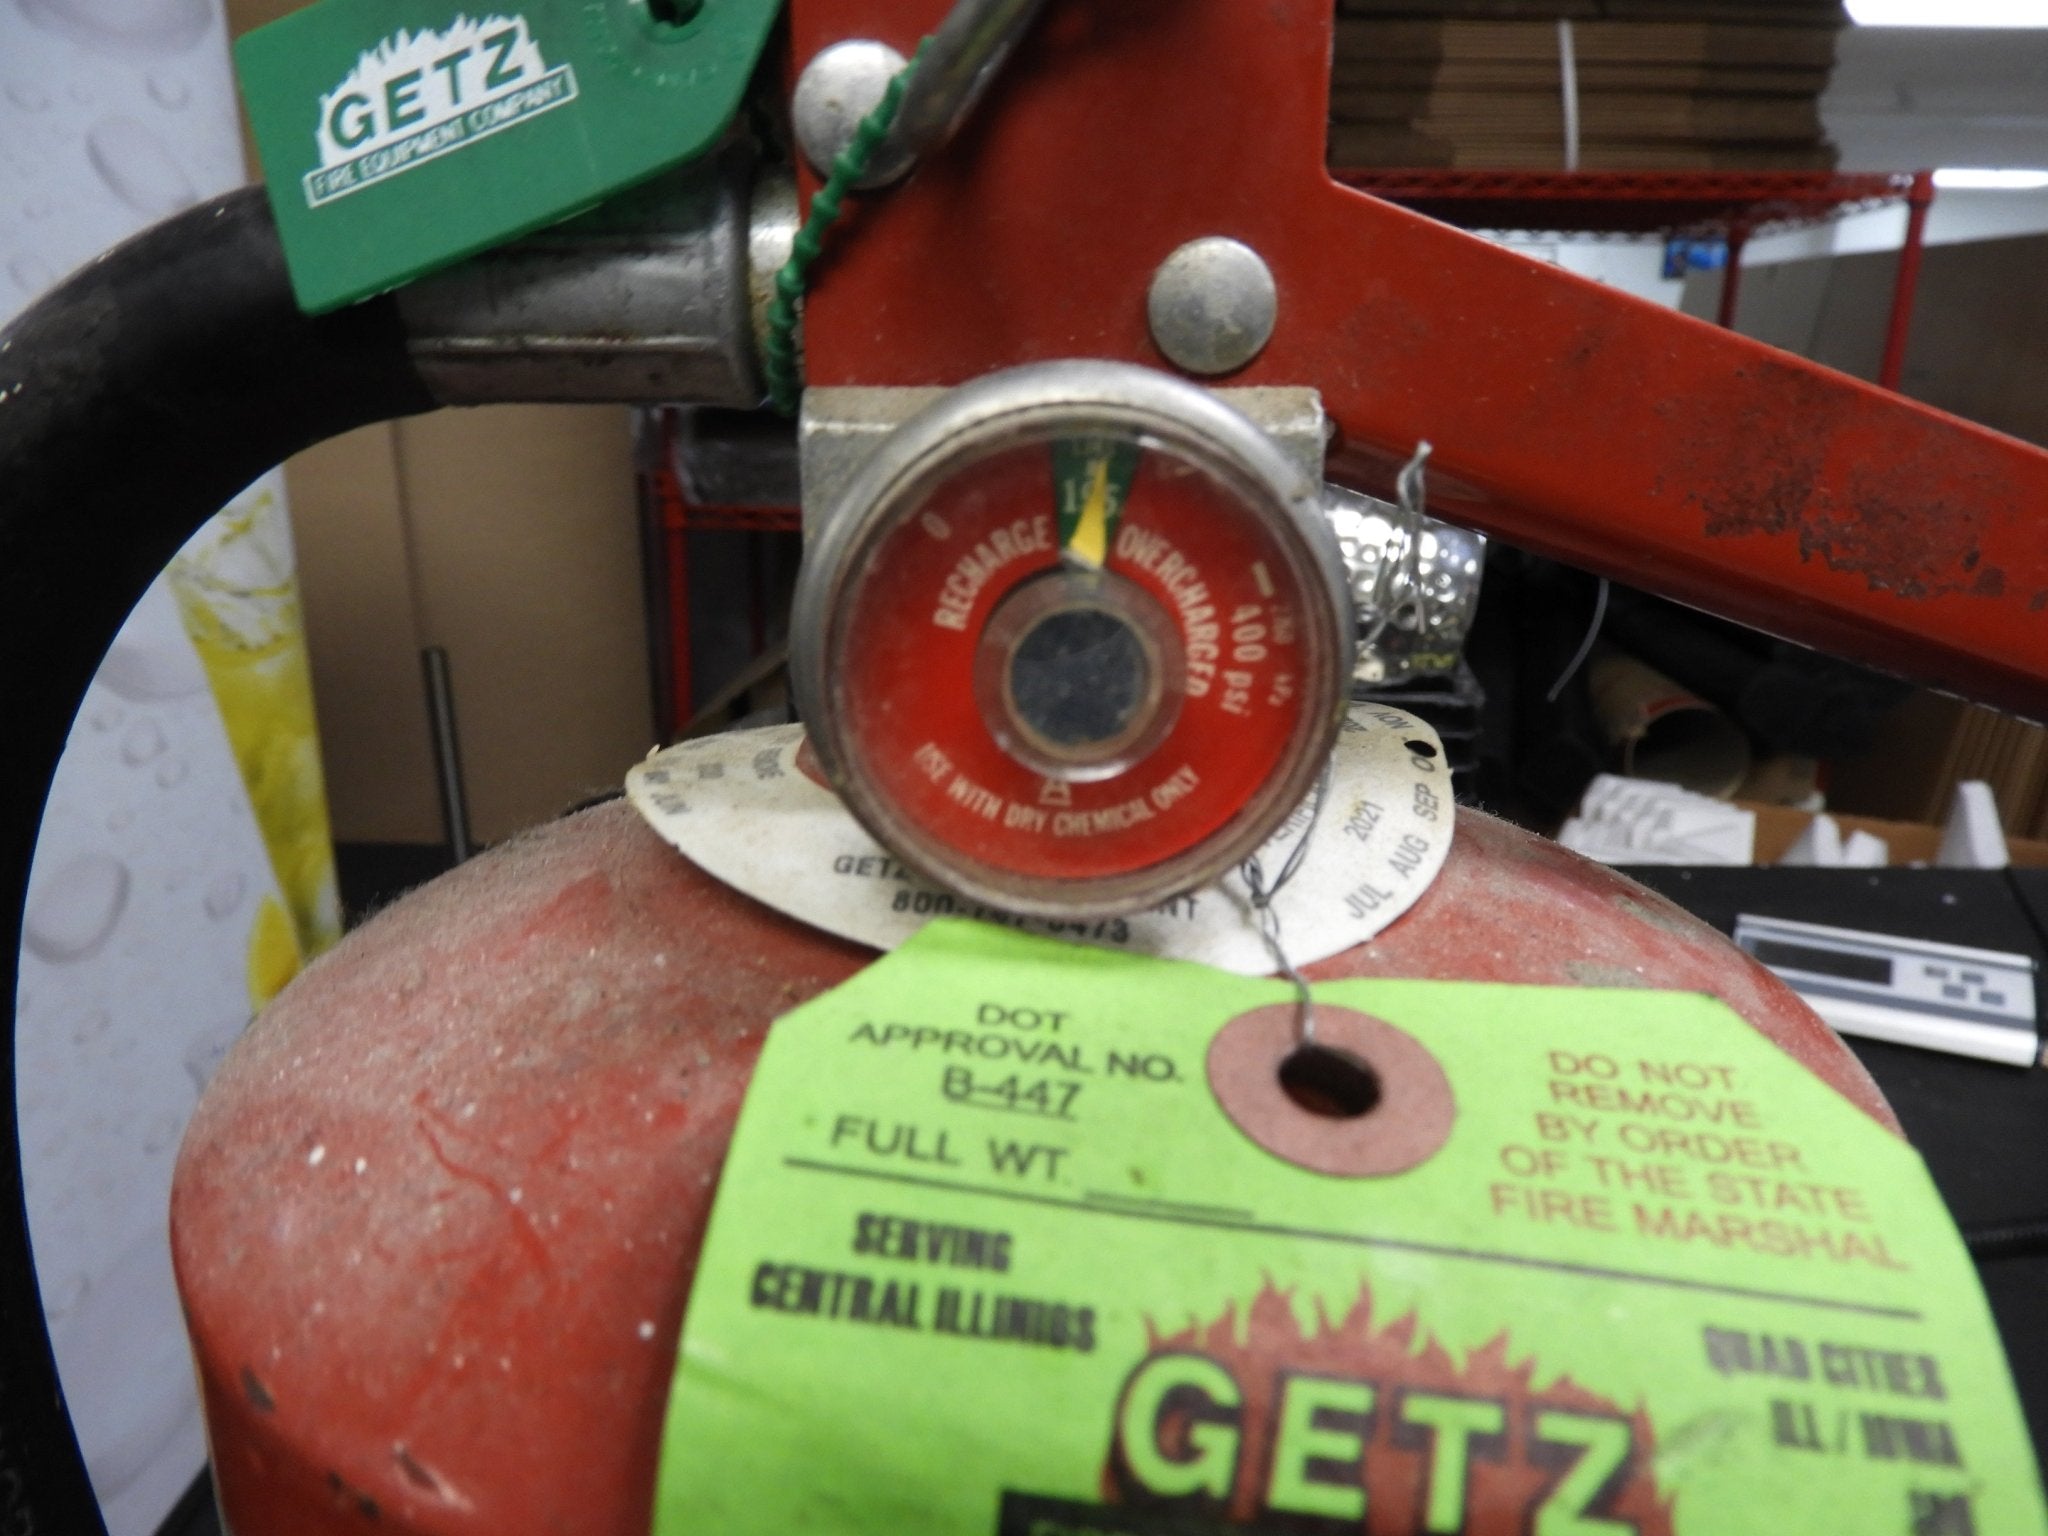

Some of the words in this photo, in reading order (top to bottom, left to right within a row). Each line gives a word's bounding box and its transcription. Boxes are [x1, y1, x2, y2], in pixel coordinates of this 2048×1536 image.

[329, 23, 525, 150] GETZ
[359, 117, 465, 174] EQUIPMENT
[467, 75, 564, 131] COMPANY
[932, 515, 1053, 632] RECHARGE
[1116, 523, 1219, 698] OVERCHARGED
[1230, 603, 1268, 663] 400
[912, 741, 952, 785] USE
[947, 773, 1003, 821] WITH
[1004, 801, 1048, 833] DRY
[1052, 798, 1155, 837] CHEMICAL
[1150, 763, 1200, 811] ONLY
[1412, 783, 1439, 823] SEP
[1344, 799, 1386, 842] 2021
[1388, 834, 1430, 879] AUG
[1343, 884, 1394, 920] JUL
[976, 1003, 1070, 1033] DOT
[848, 1023, 1093, 1074] APPROVAL
[1106, 1049, 1188, 1083] NO.
[1549, 1050, 1620, 1080] DO
[1639, 1060, 1738, 1092] NOT
[941, 1066, 1083, 1115] B-447
[1548, 1080, 1763, 1129] REMOVE
[830, 1114, 962, 1167] FULL
[1534, 1112, 1602, 1144] BY
[1618, 1123, 1808, 1173] ORDER
[1500, 1144, 1572, 1178] OF
[1586, 1155, 1694, 1200] THE
[1706, 1171, 1873, 1224] STATE
[852, 1211, 1013, 1275] SERVING
[1490, 1184, 1619, 1233] FIRE
[1632, 1203, 1913, 1272] MARSHAL
[750, 1261, 922, 1332] CENTRAL
[930, 1287, 1099, 1354] ILLINOIS
[1113, 1350, 1642, 1536] GETZ
